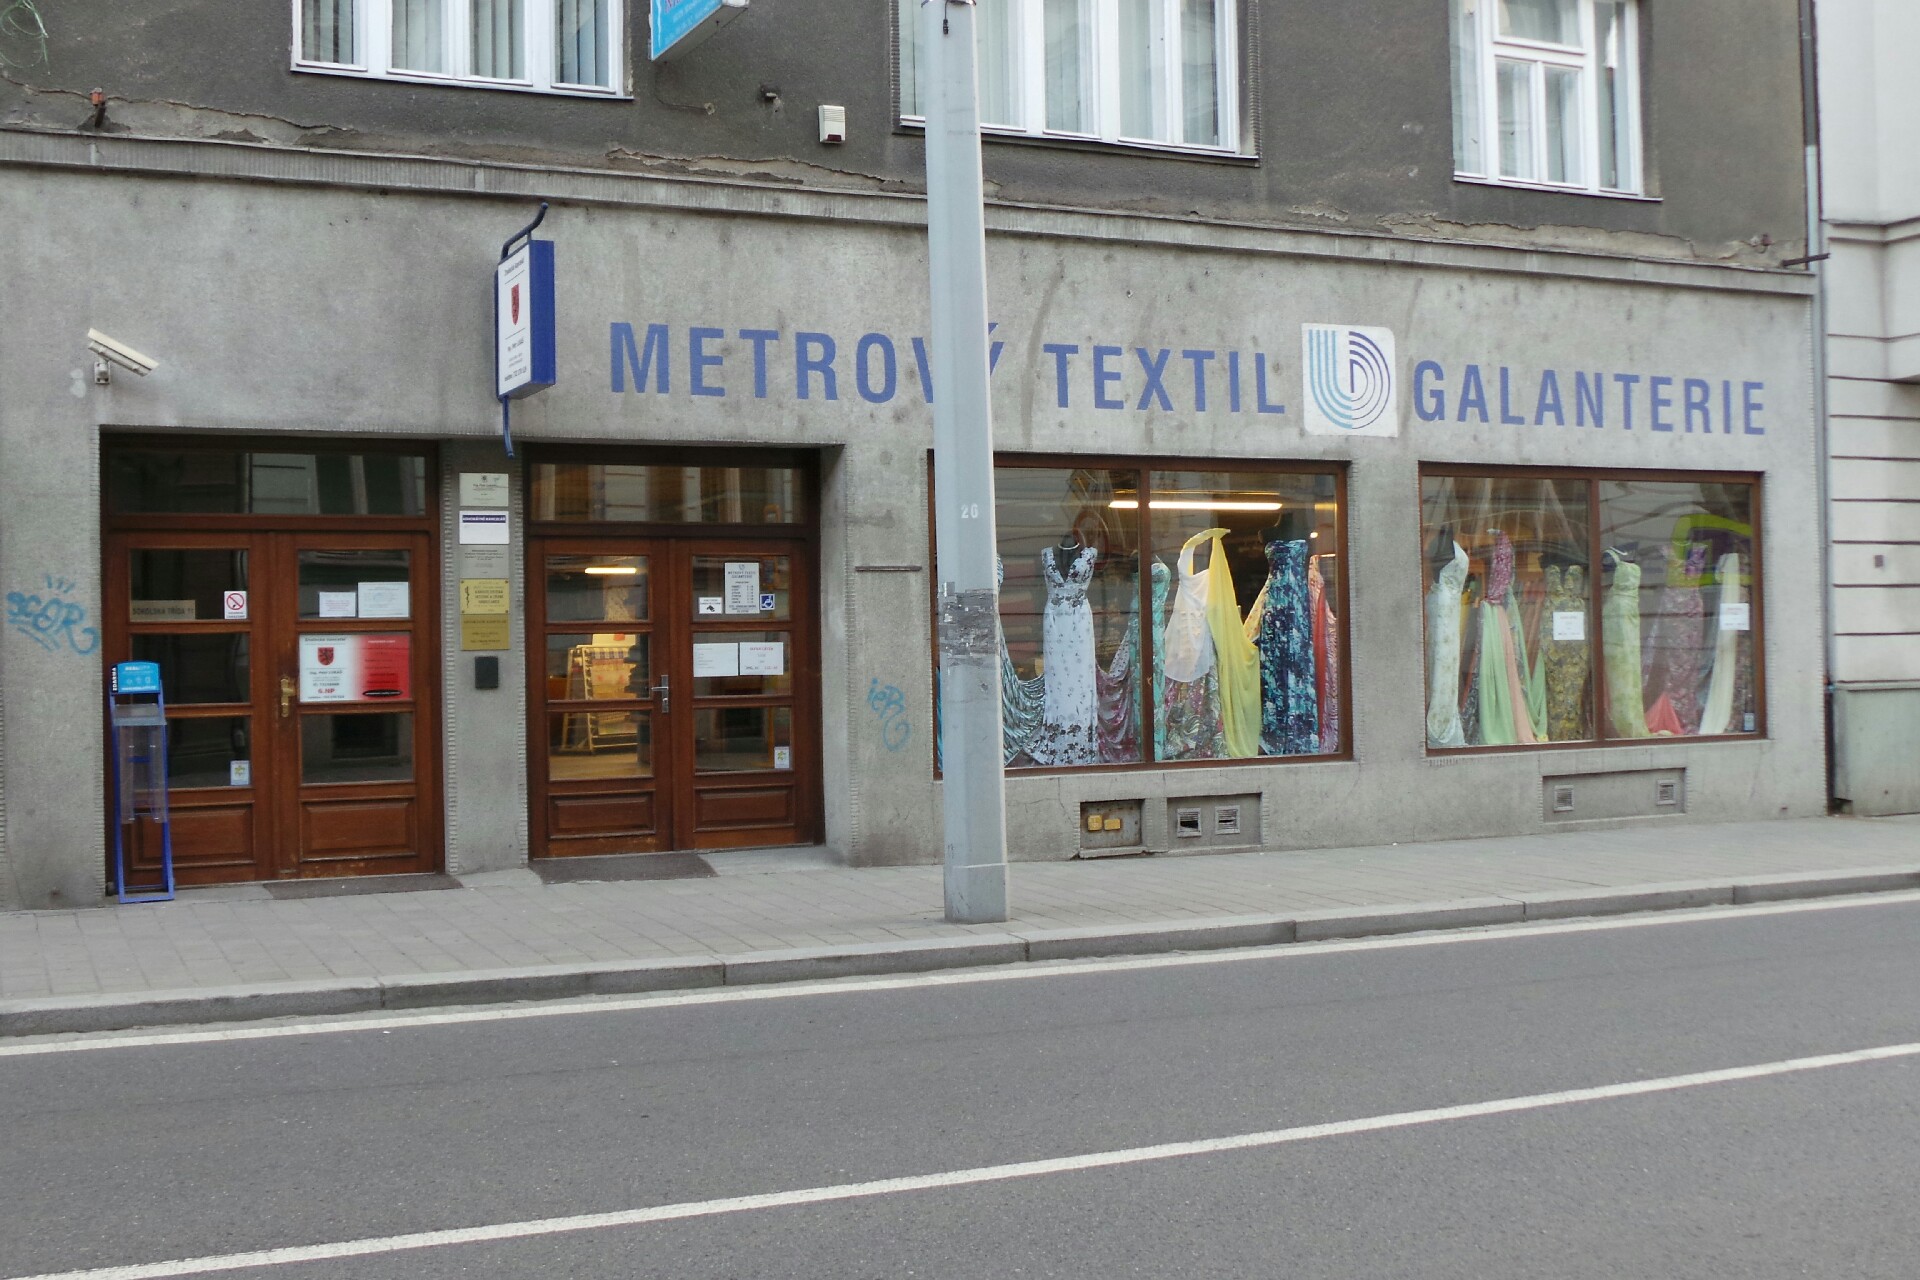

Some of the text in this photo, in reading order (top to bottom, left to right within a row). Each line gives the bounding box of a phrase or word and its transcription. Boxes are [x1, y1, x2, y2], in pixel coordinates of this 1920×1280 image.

[610, 322, 1766, 436] METRO TEXTIL GALANTERIE
